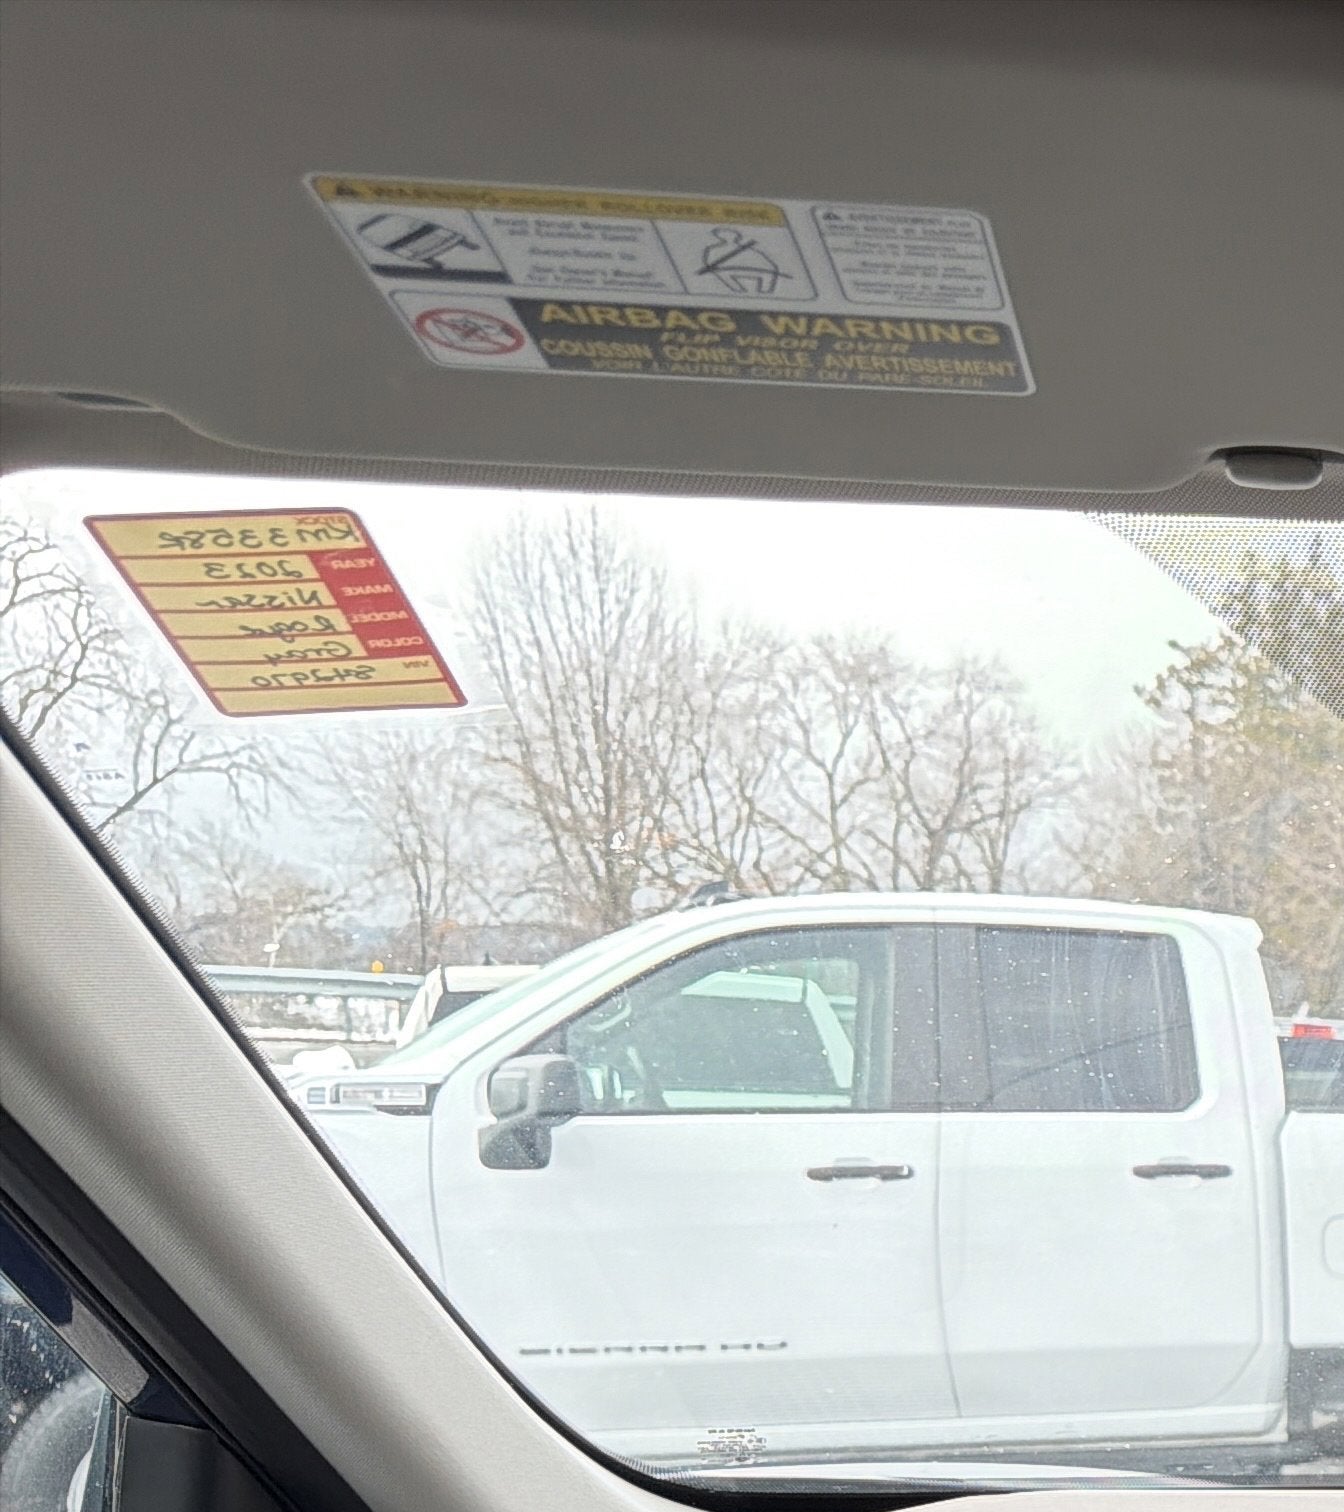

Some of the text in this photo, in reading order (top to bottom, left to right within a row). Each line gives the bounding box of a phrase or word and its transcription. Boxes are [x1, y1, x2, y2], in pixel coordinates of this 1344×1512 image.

[539, 301, 1003, 347] AIRBAG WARNING
[659, 331, 911, 355] FLIP VISOR OVER
[540, 338, 1018, 377] COUSSIN GONFLABLE AVERTISSEMENT
